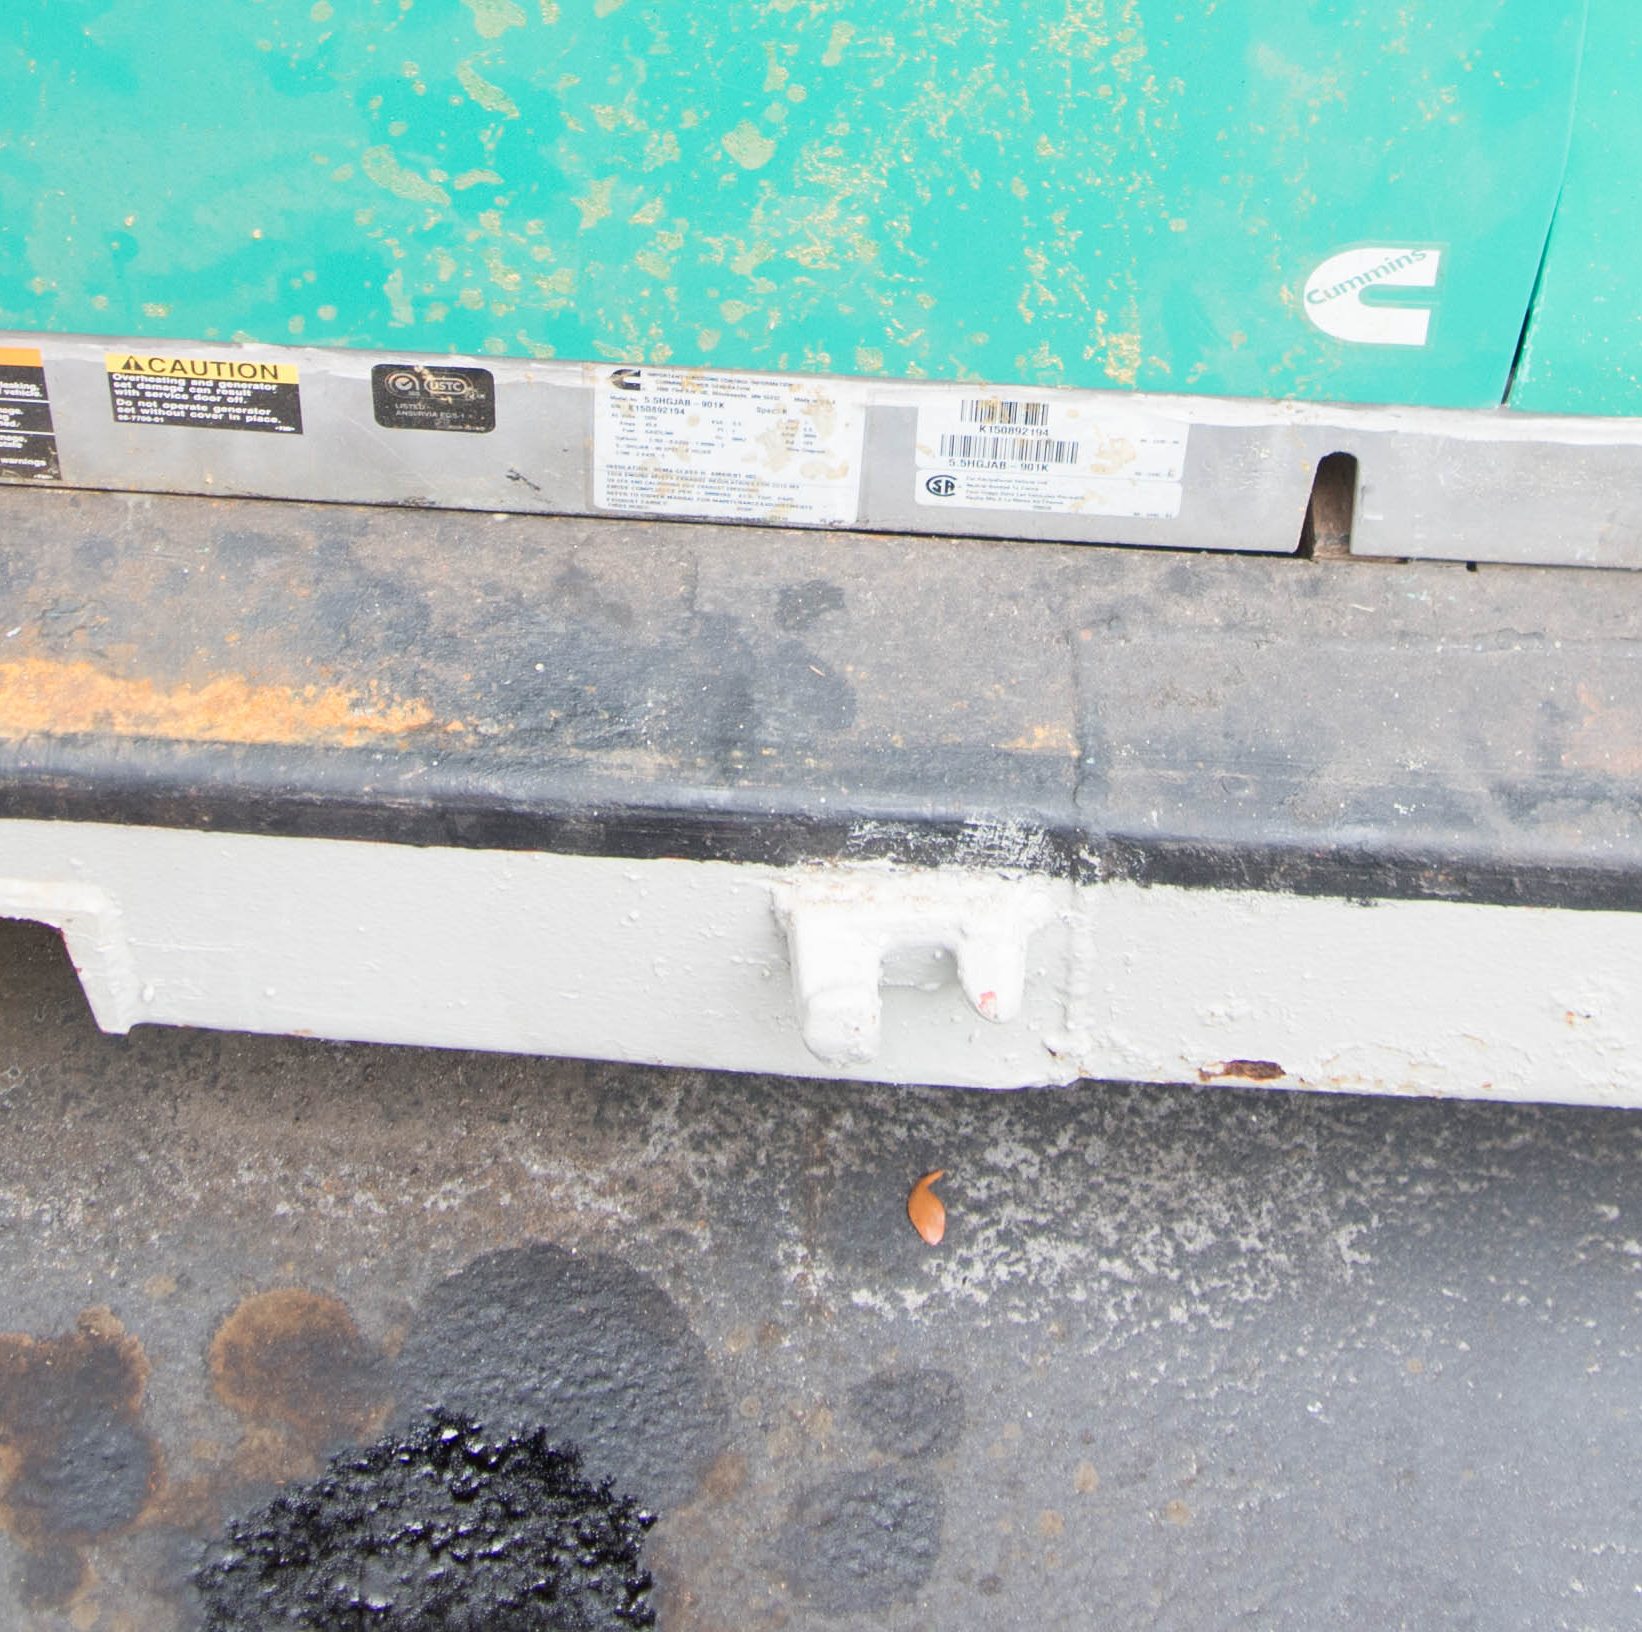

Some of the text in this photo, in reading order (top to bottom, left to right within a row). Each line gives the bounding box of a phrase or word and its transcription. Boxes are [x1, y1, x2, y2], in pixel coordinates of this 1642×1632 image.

[1306, 249, 1427, 305] Cummins
[147, 357, 279, 380] CAUTION
[0, 382, 39, 393] leaking,
[112, 373, 277, 392] Overheating and generator
[113, 381, 132, 389] set
[136, 382, 185, 394] damage
[216, 388, 252, 396] result
[3, 389, 43, 398] vehicle.
[114, 388, 247, 404] with service door off.
[116, 398, 272, 416] Do not operate generator
[116, 406, 282, 424] set without cover in place.
[979, 424, 1049, 437] K150892194
[0, 456, 47, 467] warnings
[1020, 464, 1049, 473] 901K
